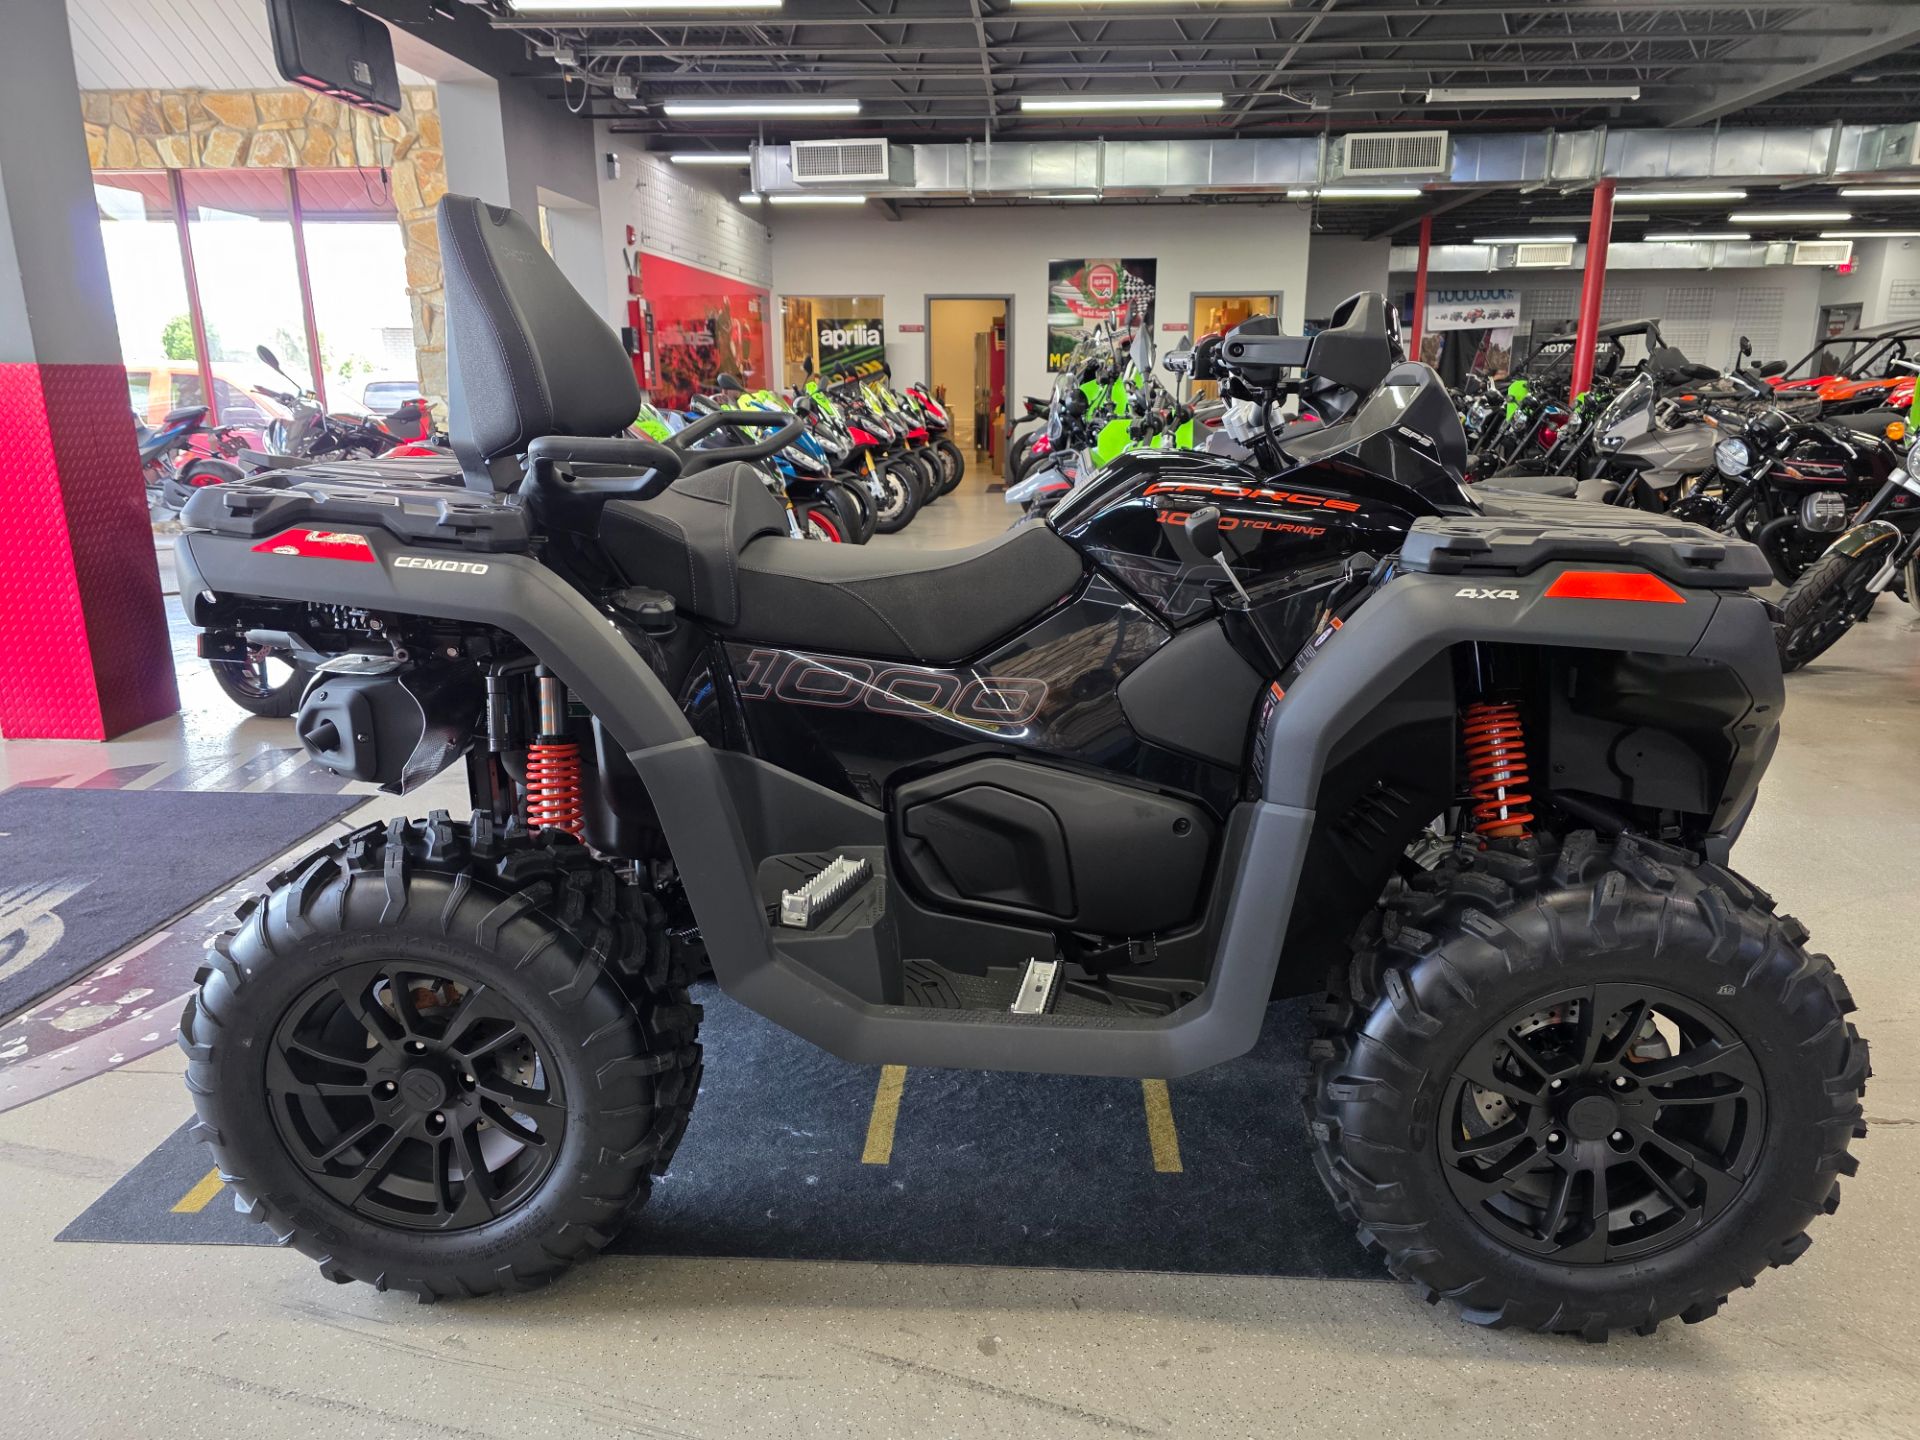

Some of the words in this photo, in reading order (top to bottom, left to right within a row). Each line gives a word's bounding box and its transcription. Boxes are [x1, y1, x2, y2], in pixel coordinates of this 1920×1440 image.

[820, 324, 881, 350] aprilia
[1397, 426, 1433, 448] EPS
[1156, 510, 1240, 531] 100
[1241, 519, 1327, 537] TOURING
[393, 556, 490, 576] CFMOTO
[737, 648, 1050, 727] 1000
